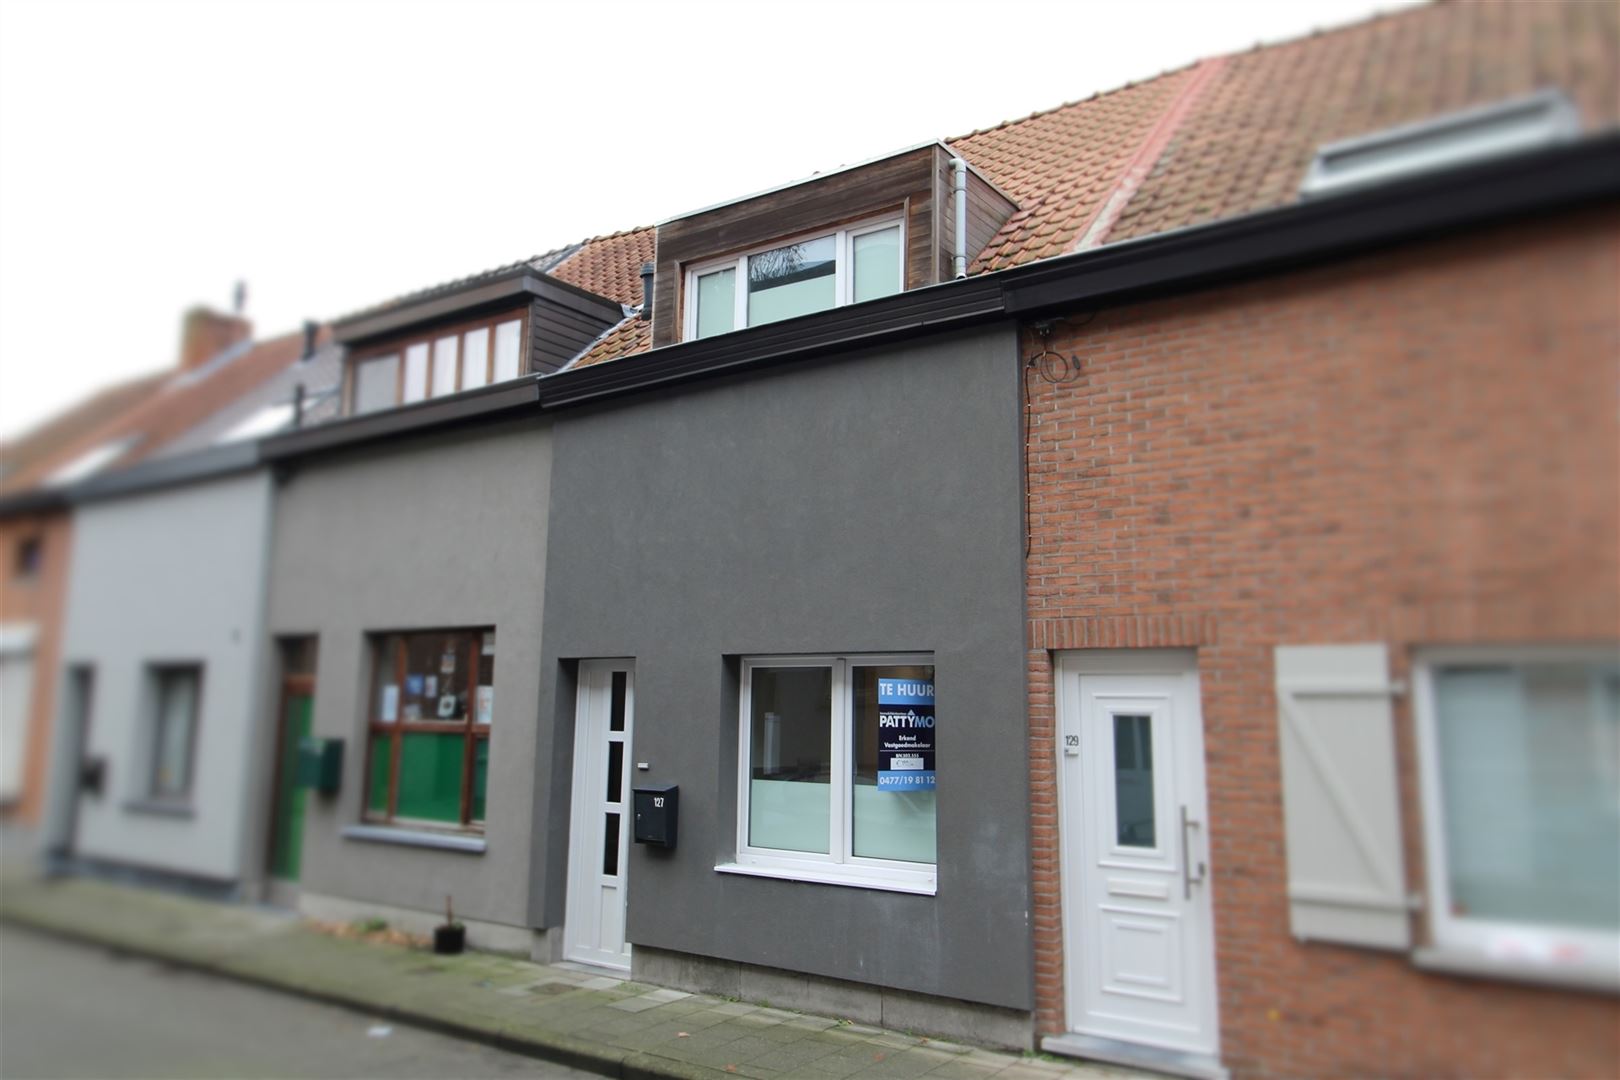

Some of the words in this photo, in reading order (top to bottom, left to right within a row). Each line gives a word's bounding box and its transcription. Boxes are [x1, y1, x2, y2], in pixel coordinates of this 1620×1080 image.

[879, 683, 893, 696] TE
[897, 683, 934, 697] HUUR
[879, 715, 935, 728] PATTYMO
[1065, 735, 1079, 746] 129
[879, 775, 914, 785] 0477/19
[915, 775, 925, 784] 81
[653, 797, 665, 807] 127
